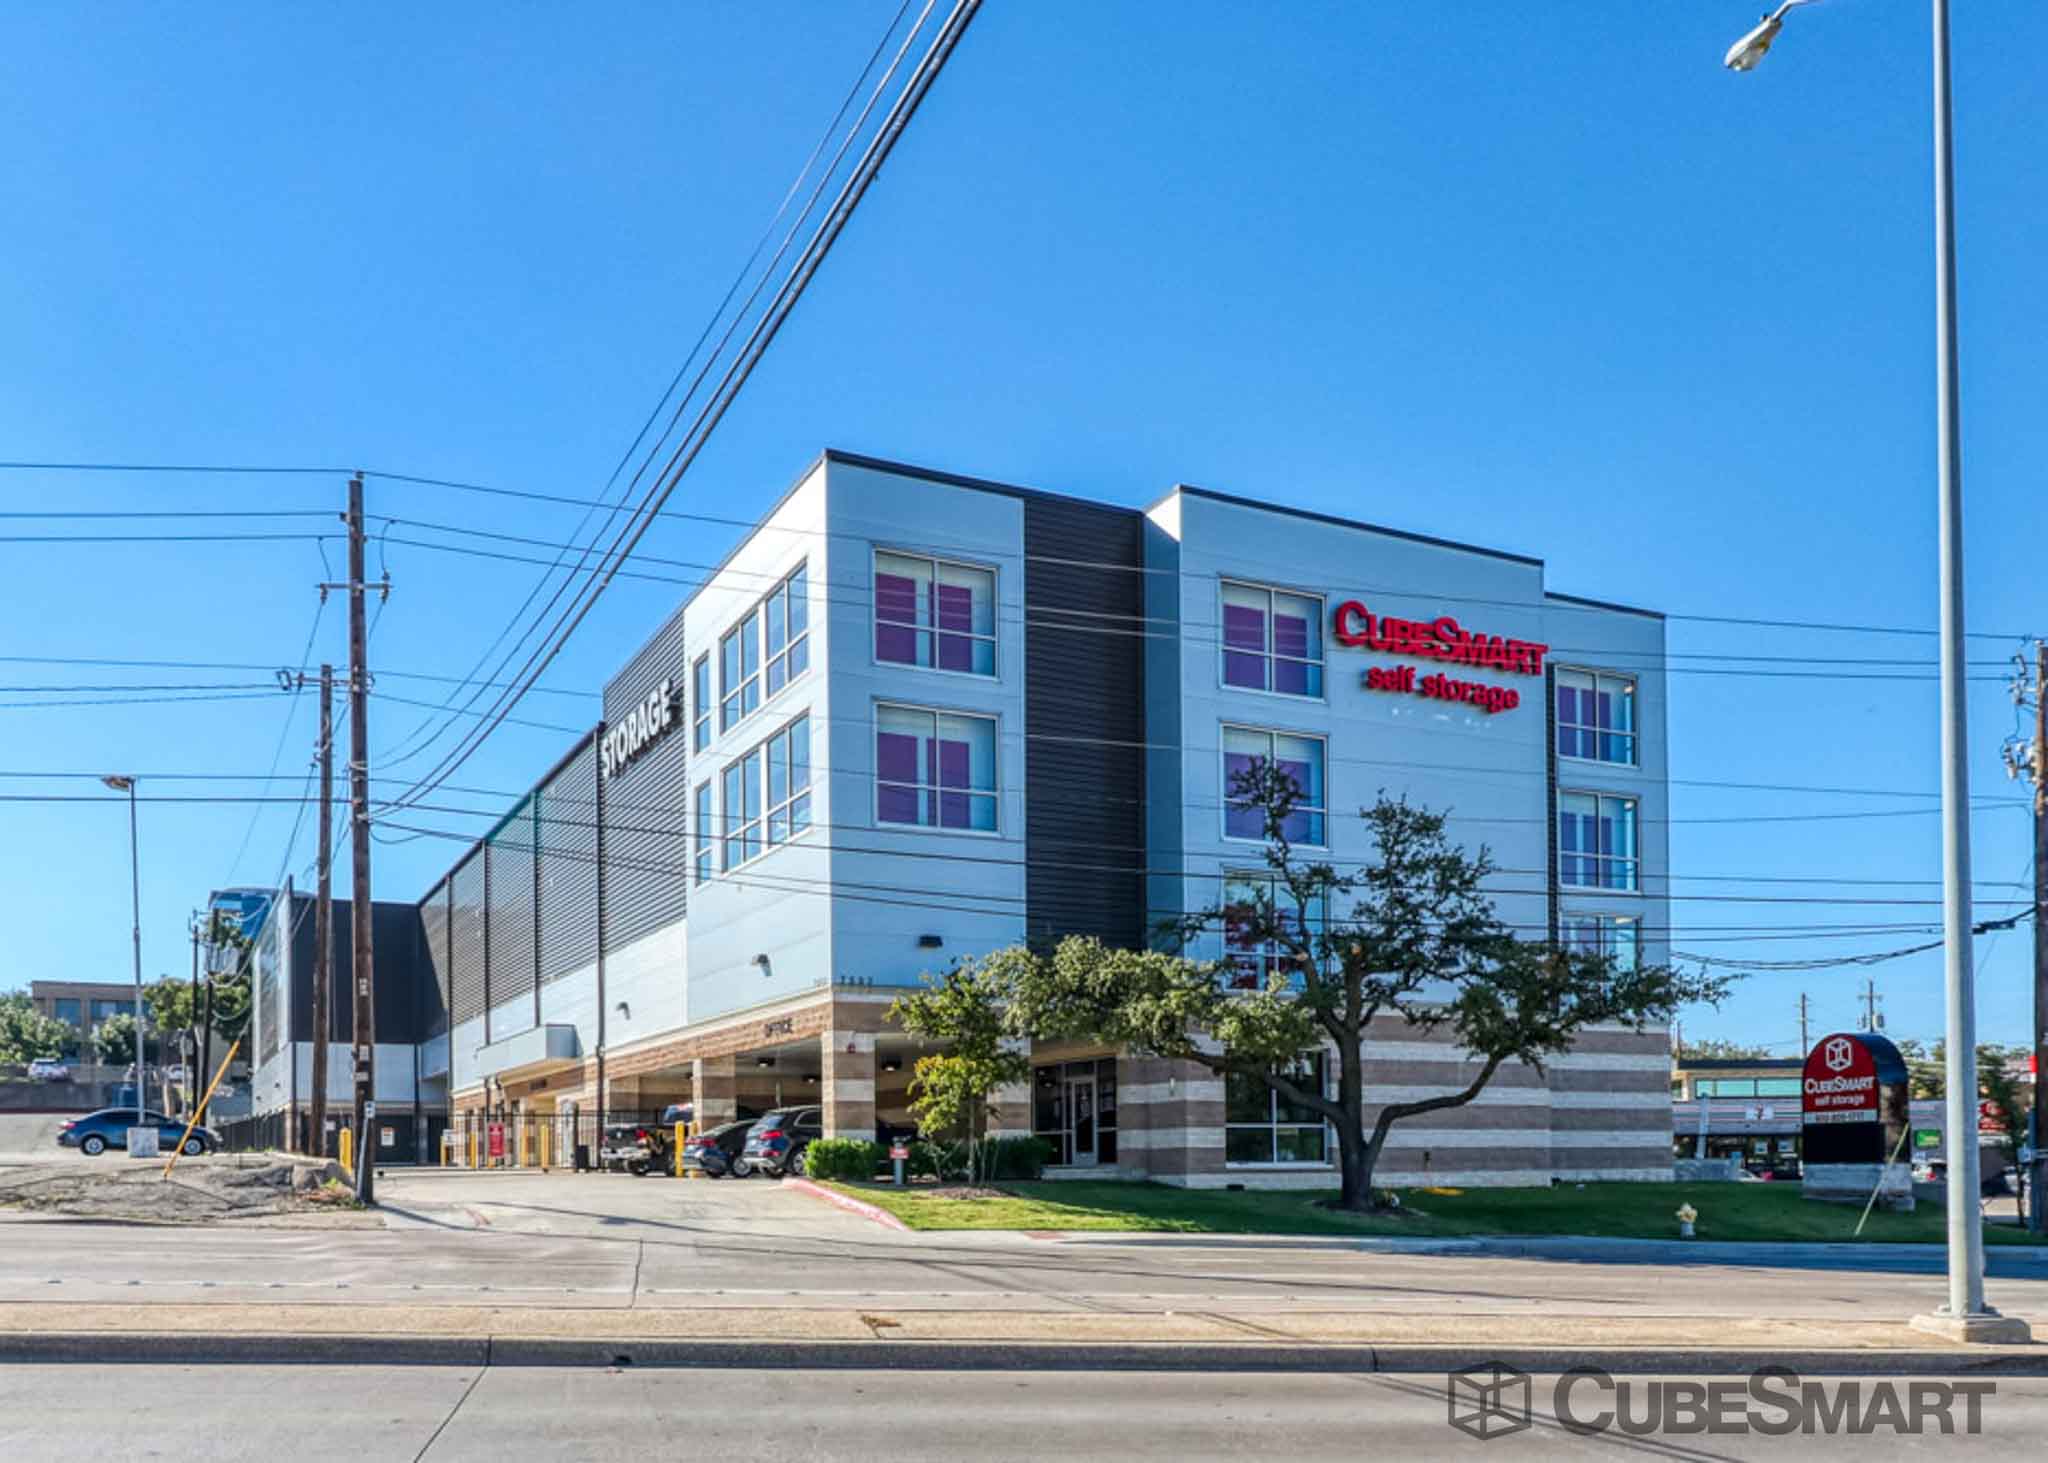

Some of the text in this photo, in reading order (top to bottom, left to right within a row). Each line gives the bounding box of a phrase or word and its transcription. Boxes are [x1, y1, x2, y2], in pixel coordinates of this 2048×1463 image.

[1335, 600, 1548, 675] CUBESMART
[1368, 665, 1520, 713] self storage
[601, 678, 671, 778] STORAGE
[1804, 1076, 1875, 1094] CUBESMART
